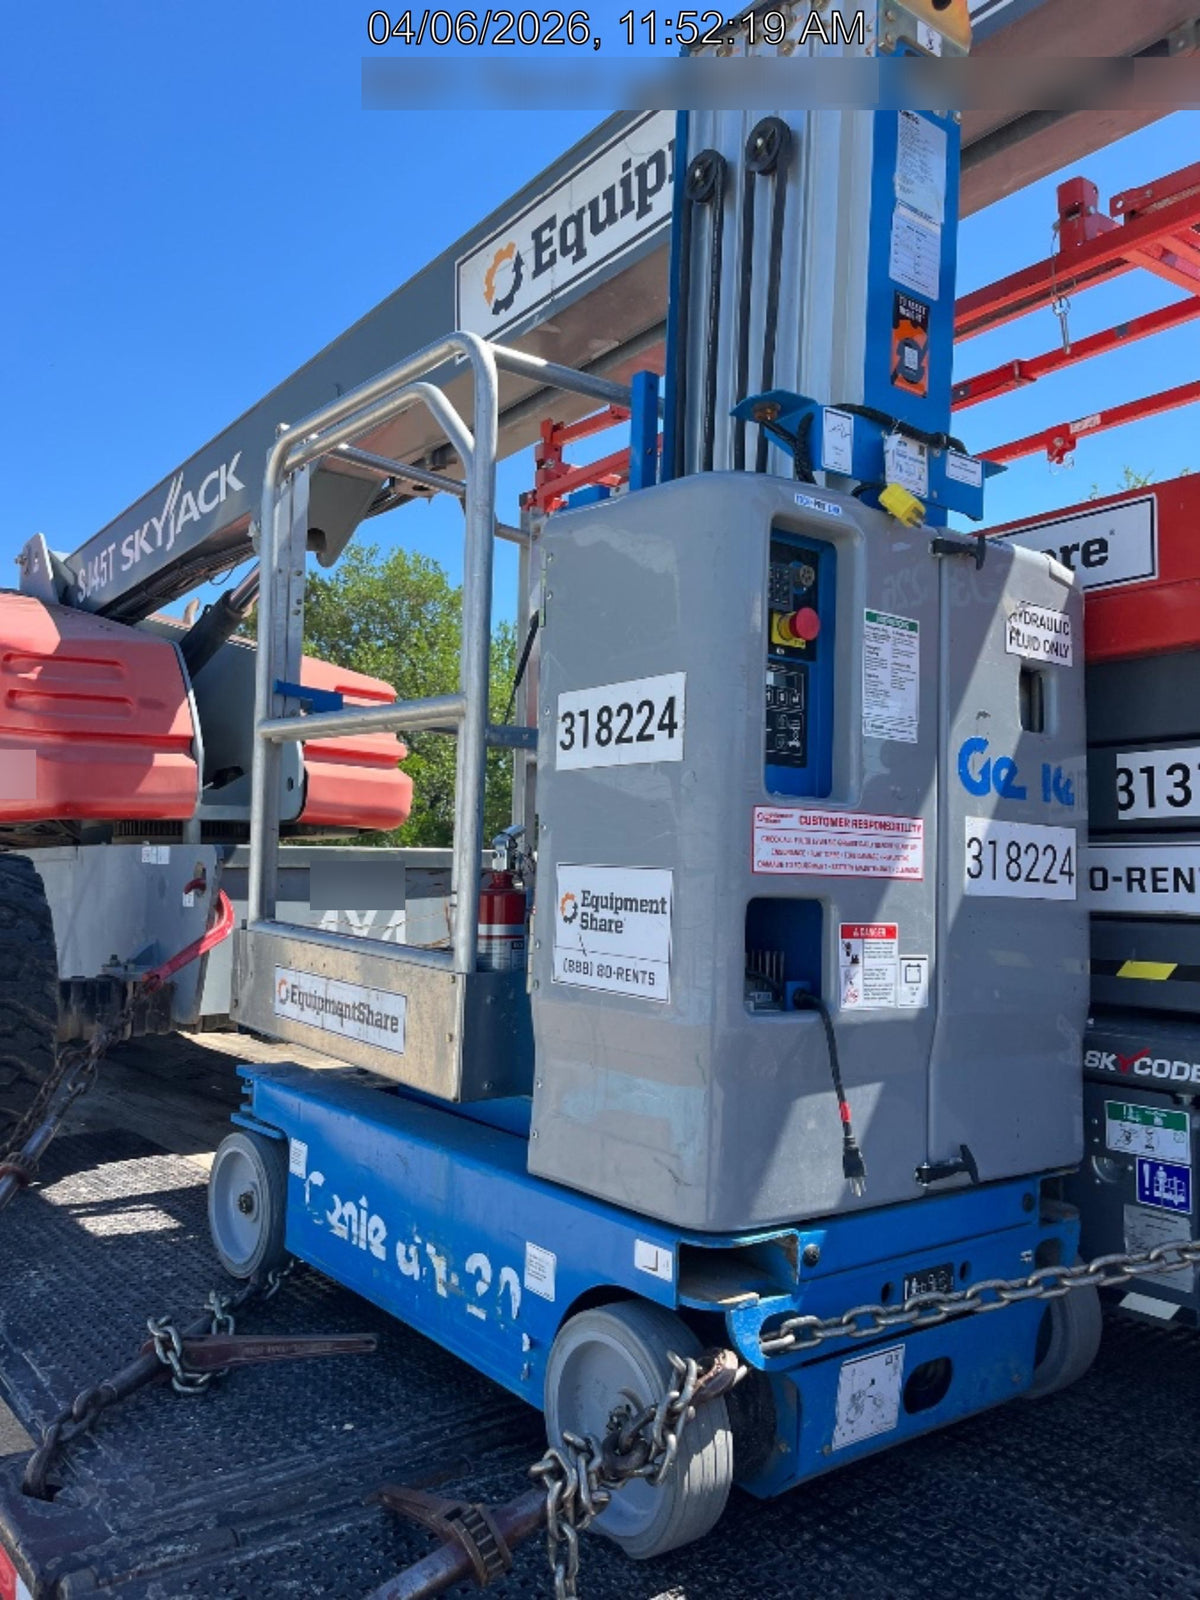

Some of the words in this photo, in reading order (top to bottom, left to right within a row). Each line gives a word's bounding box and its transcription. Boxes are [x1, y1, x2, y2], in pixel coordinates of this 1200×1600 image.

[531, 138, 675, 280] Equip
[121, 451, 246, 571] SKYJACK
[1043, 639, 1070, 659] ONLY
[559, 695, 678, 751] 318224
[1116, 762, 1200, 812] 313
[799, 815, 850, 828] CUSTOMER
[851, 819, 922, 833] RESPONSIBILITY
[966, 836, 1075, 886] 318224
[580, 889, 668, 916] Equipment
[580, 911, 624, 934] Share
[290, 983, 400, 1034] EquipmentShare
